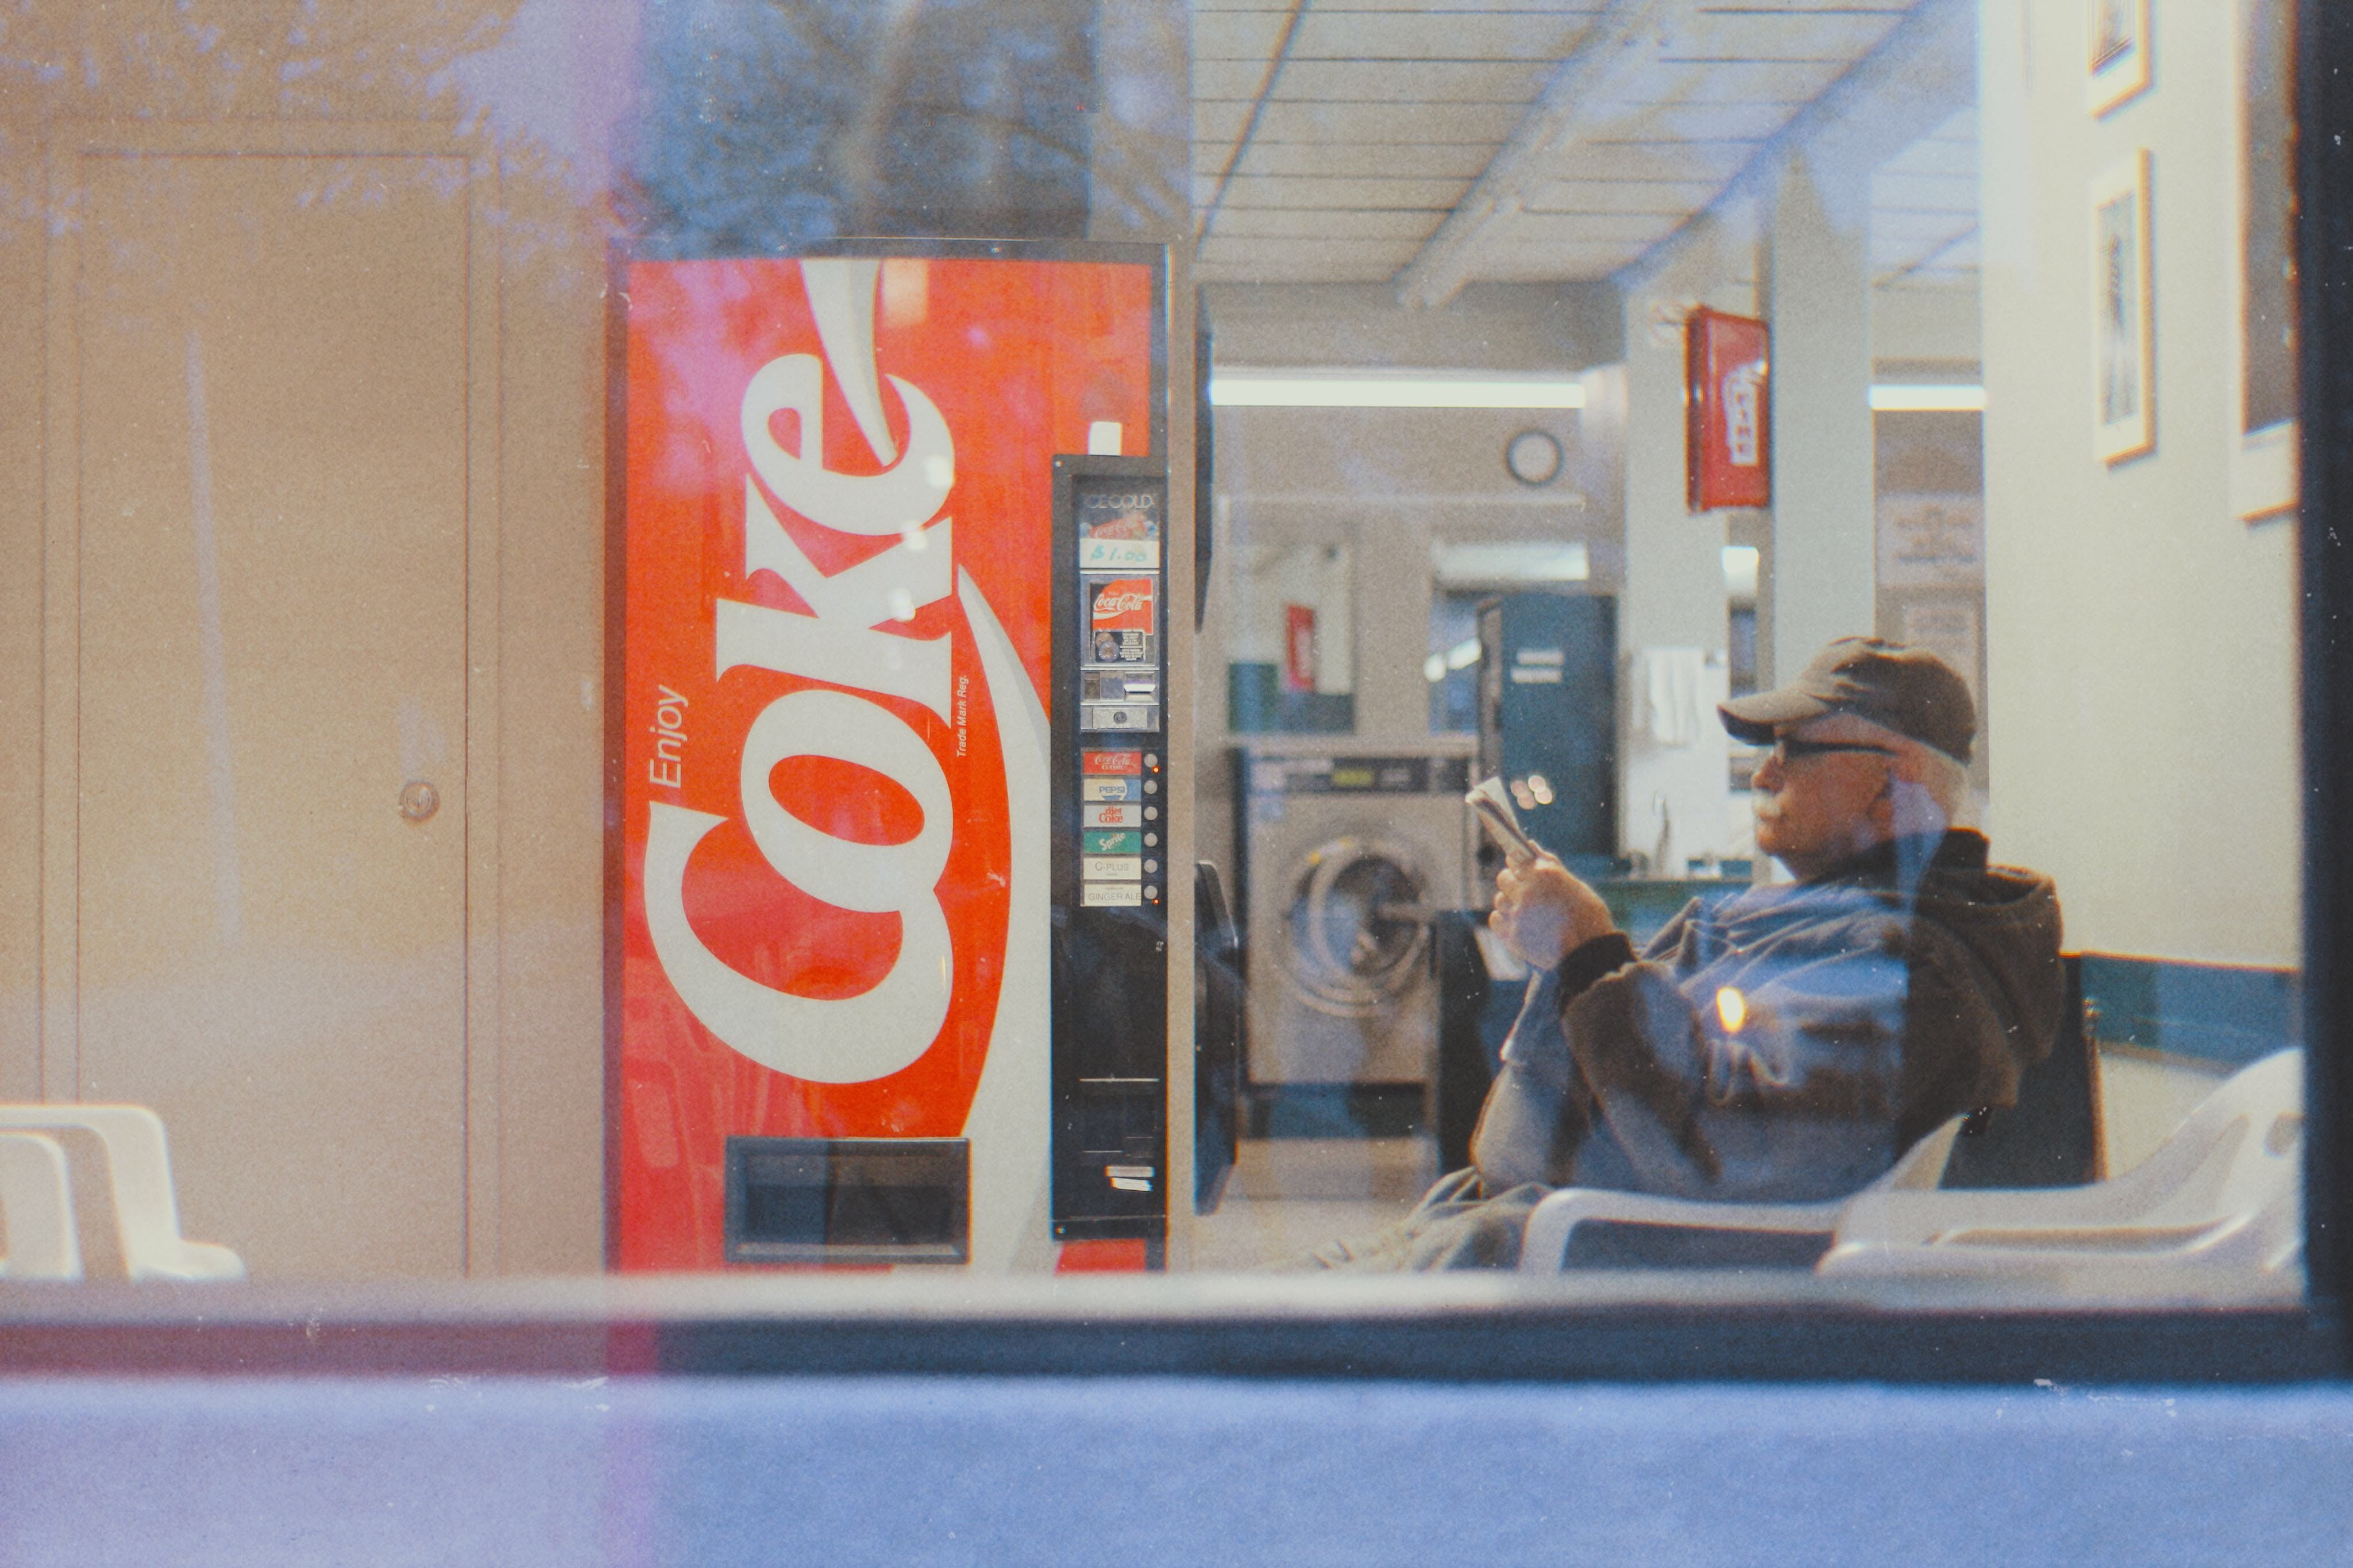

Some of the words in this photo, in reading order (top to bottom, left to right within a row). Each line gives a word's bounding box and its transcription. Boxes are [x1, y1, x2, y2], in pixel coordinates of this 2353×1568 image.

[1109, 495, 1152, 509] COLD
[1094, 593, 1143, 612] Coca-Cola
[957, 675, 969, 697] Reg.
[643, 352, 956, 1084] Coke
[956, 700, 967, 726] Mark
[649, 684, 689, 789] Enjoy
[956, 728, 967, 757] Trade
[1098, 813, 1123, 823] Coke
[1105, 806, 1122, 814] diet
[1099, 832, 1126, 851] Sprite
[1089, 893, 1123, 901] GINGER
[1125, 893, 1141, 901] ALE
